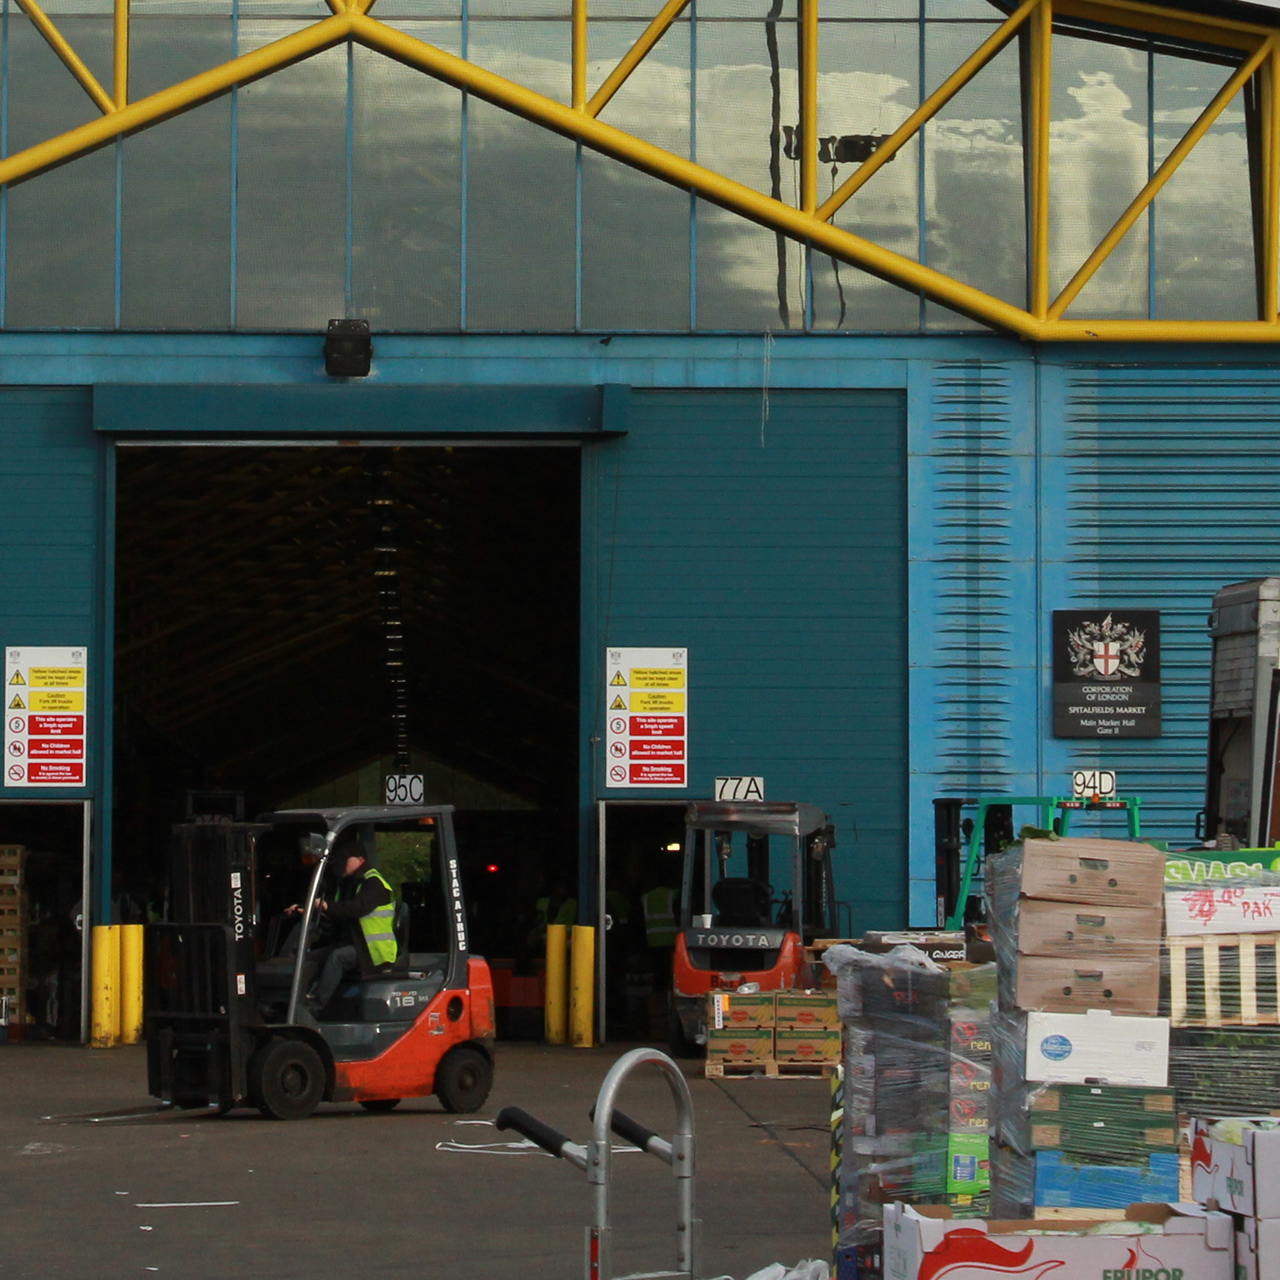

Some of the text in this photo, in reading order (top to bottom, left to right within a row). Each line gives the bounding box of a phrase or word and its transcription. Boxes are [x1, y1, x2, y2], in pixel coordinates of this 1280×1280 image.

[1086, 693, 1129, 701] OF LONDON
[1068, 706, 1147, 714] SPITALFIELDS MARKET
[615, 721, 621, 729] 5
[1096, 726, 1113, 734] Gate
[386, 775, 423, 802] 95C
[716, 777, 763, 800] 77A
[1073, 771, 1115, 795] 94D
[449, 859, 467, 951] STAC A TRUC
[1241, 899, 1273, 920] PAK
[233, 888, 244, 942] TOYOTA
[696, 933, 770, 947] TOYOTA
[932, 950, 965, 959] GINGER
[395, 996, 415, 1007] 18
